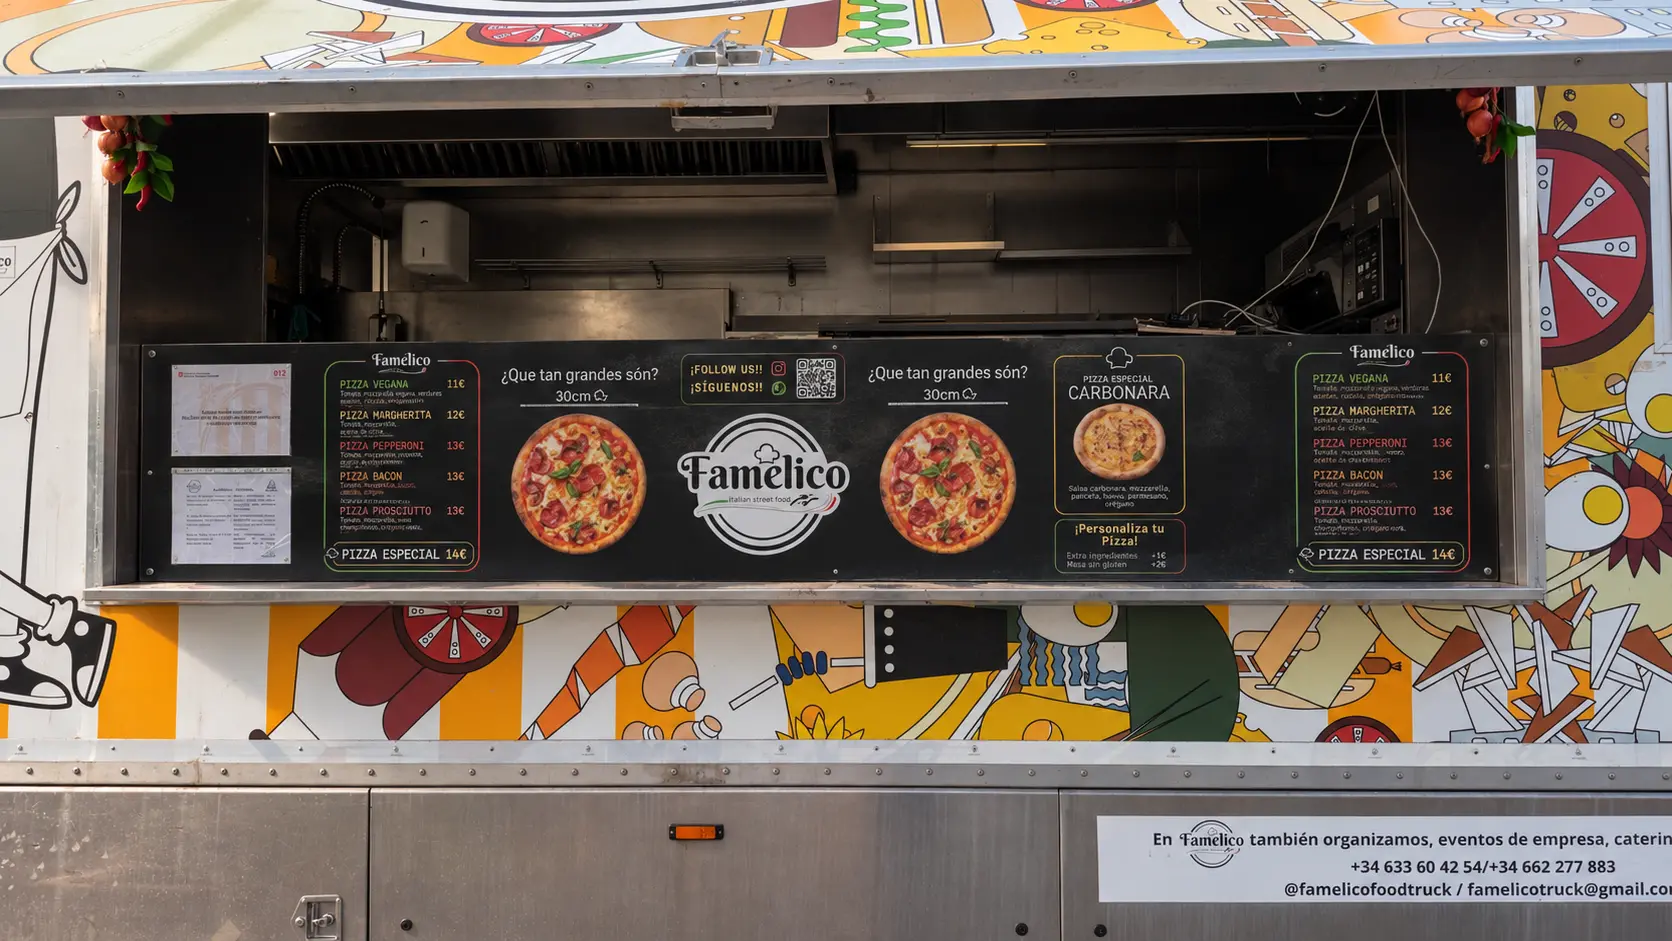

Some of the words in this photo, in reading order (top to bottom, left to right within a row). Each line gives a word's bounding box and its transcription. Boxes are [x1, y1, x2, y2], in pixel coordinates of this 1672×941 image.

[691, 365, 736, 375] ¡FOLLOW
[741, 365, 762, 374] US!!
[869, 366, 903, 382] ¿Que
[907, 367, 929, 379] tan
[934, 365, 990, 382] grandes
[995, 365, 1027, 378] són?
[502, 368, 535, 384] ¿Que
[540, 369, 561, 381] tan
[566, 368, 621, 384] grandes
[626, 368, 658, 380] són?
[1313, 374, 1344, 383] PIZZA
[1350, 374, 1388, 383] VEGANA
[1433, 373, 1451, 382] 11€
[340, 380, 368, 389] PIZZA
[373, 380, 408, 388] VEGANA
[448, 379, 464, 388] 11€
[691, 380, 762, 394] ¡SÍGUENOS!!
[556, 391, 590, 402] 30cm
[924, 389, 959, 400] 30cm
[1069, 385, 1170, 399] CARBONARA
[340, 411, 368, 419] PIZZA
[373, 410, 431, 419] MARGHERITA
[448, 410, 464, 419] 12€
[1314, 406, 1344, 415] PIZZA
[1350, 406, 1415, 415] MARGHERITA
[1433, 406, 1451, 415] 12€
[340, 442, 368, 450] PIZZA
[373, 441, 423, 450] PEPPERONI
[448, 441, 464, 450] 13€
[1314, 439, 1344, 447] PIZZA
[1350, 438, 1407, 447] PEPPERONI
[1433, 438, 1452, 447] 13€
[340, 472, 368, 481] PIZZA
[373, 472, 402, 480] BACON
[448, 472, 464, 480] 13€
[1314, 471, 1345, 479] PIZZA
[1350, 470, 1383, 480] BACON
[1434, 471, 1452, 480] 13€
[340, 506, 368, 515] PIZZA
[373, 507, 431, 515] PROSCIUTTO
[448, 506, 464, 515] 13€
[1314, 507, 1345, 516] PIZZA
[1351, 506, 1416, 515] PROSCIUTTO
[1434, 507, 1452, 515] 13€
[1076, 523, 1148, 535] ¡Personaliza
[1152, 524, 1164, 533] tu
[1102, 536, 1137, 545] Pizza!
[343, 549, 377, 559] PIZZA
[383, 549, 440, 559] ESPECIAL
[446, 549, 466, 559] 14€
[1319, 549, 1358, 560] PIZZA
[1364, 549, 1425, 560] ESPECIAL
[1433, 549, 1455, 559] 14€
[1154, 833, 1171, 845] En
[1250, 832, 1317, 845] también
[1324, 833, 1432, 849] organizamos,
[1439, 834, 1503, 846] eventos
[1509, 832, 1527, 845] de
[1533, 836, 1608, 849] empresa,
[1351, 861, 1379, 873] +34
[1384, 861, 1411, 873] 633
[1417, 861, 1435, 873] 60
[1440, 861, 1458, 873] 42
[1464, 861, 1517, 873] 54/+34
[1523, 861, 1550, 873] 662
[1556, 861, 1582, 873] 277
[1588, 861, 1615, 873] 883
[1285, 882, 1451, 896] @famelicofoodtruck
[1457, 883, 1463, 896] /
[1468, 882, 1672, 899] famelicotruck@gmail.co
